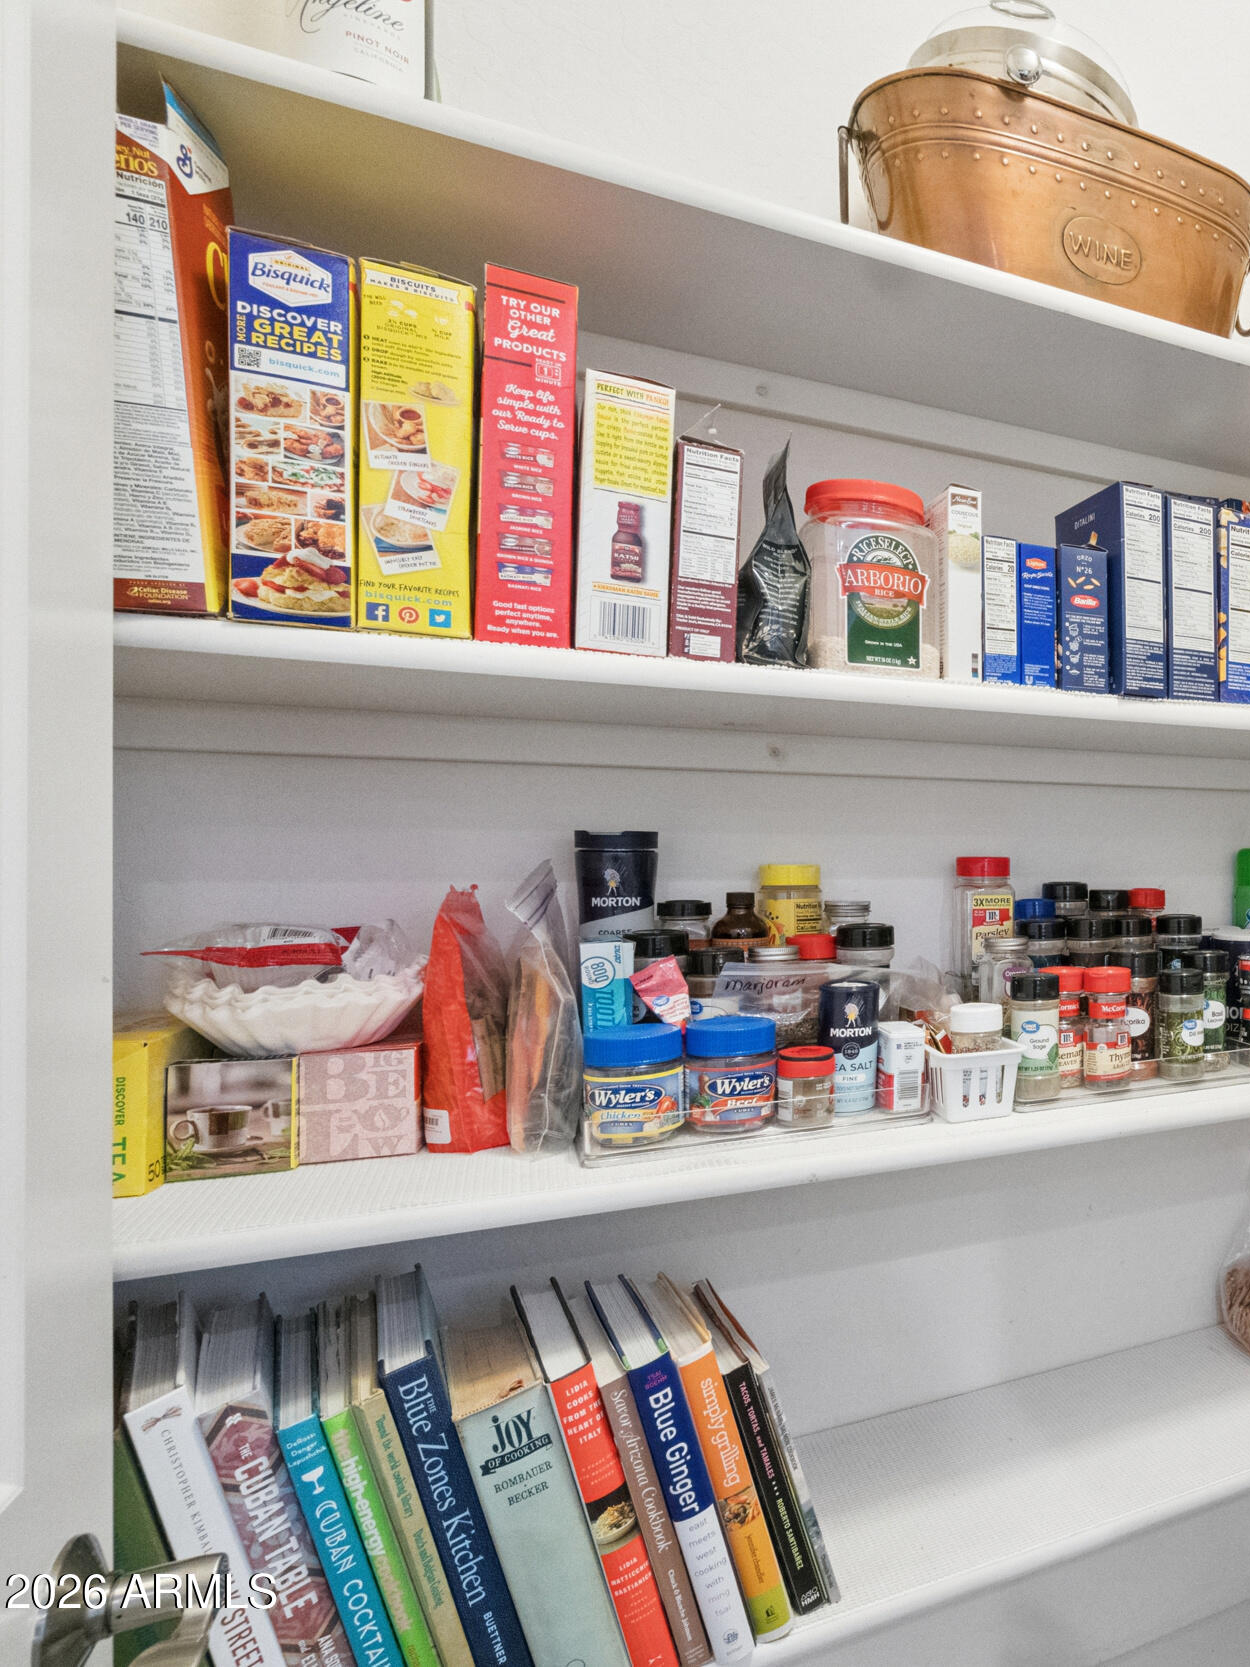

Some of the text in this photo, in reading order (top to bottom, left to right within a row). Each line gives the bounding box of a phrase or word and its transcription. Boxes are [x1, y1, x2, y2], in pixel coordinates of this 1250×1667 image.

[345, 30, 410, 65] PINOT NOIR
[125, 211, 169, 231] 140 210
[1068, 231, 1133, 271] WINE
[250, 261, 331, 295] Bisquick
[390, 275, 436, 294] BISCUITS
[501, 295, 560, 319] TRY OUR
[509, 308, 551, 327] OTHER
[235, 314, 246, 342] MORE
[236, 300, 343, 336] DISCOVER
[253, 318, 343, 349] GREAT
[507, 319, 557, 343] Great
[251, 330, 343, 363] RECIPES
[494, 337, 568, 363] PRODUCTS
[268, 357, 341, 380] bisquick.com
[505, 383, 556, 402] Keep life
[596, 382, 645, 400] PERFECT WITH
[497, 396, 562, 416] simple with
[492, 409, 565, 431] our Ready to
[497, 419, 529, 436] Serve
[686, 447, 740, 463] Nutrition Facts
[1074, 512, 1096, 532] DITALINI
[1125, 509, 1161, 523] Calories 200
[1173, 522, 1212, 536] Calories 200
[852, 536, 914, 568] RICESELECT
[360, 579, 460, 598] FIND YOUR FAVORITE RECIPES
[844, 567, 923, 596] ARBORIO
[365, 590, 452, 607] bisquick.com
[874, 587, 895, 599] RICE
[1074, 597, 1098, 607] Barilla
[487, 624, 508, 635] Ready
[591, 896, 641, 908] MORTON
[973, 896, 1012, 907] 3X MORE
[974, 926, 1011, 941] Parsley
[590, 961, 610, 984] 800
[829, 1026, 873, 1038] MORTON
[1030, 1037, 1050, 1045] Ground
[1032, 1043, 1047, 1051] Sage
[850, 1060, 874, 1072] SALT
[715, 1074, 771, 1095] Wyler's
[114, 1075, 126, 1128] DISCOVER
[594, 1087, 658, 1108] Wyler's
[727, 1097, 761, 1107] Beef
[600, 1110, 641, 1121] Chicken
[147, 1159, 162, 1184] 50
[565, 1380, 589, 1397] LIDIA
[425, 1391, 438, 1414] THE
[566, 1390, 594, 1410] COOKS
[609, 1388, 633, 1429] Savor
[562, 1408, 588, 1425] FROM
[490, 1407, 537, 1455] JOY
[566, 1418, 594, 1437] HEART
[579, 1427, 602, 1446] ITALY
[700, 1377, 742, 1489] simply grilling
[738, 1381, 775, 1480] TACOS, TORTAS, TAMALES
[487, 1434, 550, 1471] OF COOKING
[618, 1429, 650, 1487] Arizona
[648, 1386, 700, 1514] Blue Ginger
[160, 1428, 196, 1511] CHRISTOPHER
[493, 1459, 554, 1495] ROMBAUER
[397, 1373, 489, 1608] Blue Zones Kitchen
[506, 1480, 550, 1508] BECKER
[338, 1455, 387, 1557] high-energy
[775, 1497, 791, 1530] ROBERTO
[641, 1486, 673, 1554] Cookbook
[688, 1517, 708, 1532] east
[235, 1442, 319, 1620] THE CUBAN TABLE
[315, 1500, 357, 1575] CUBAN
[688, 1529, 717, 1549] meets
[695, 1545, 718, 1561] west
[694, 1556, 728, 1579] cooking
[704, 1575, 725, 1590] with
[801, 1592, 821, 1608] HMH
[220, 1607, 265, 1667] STREET
[482, 1611, 508, 1667] BUETTNER
